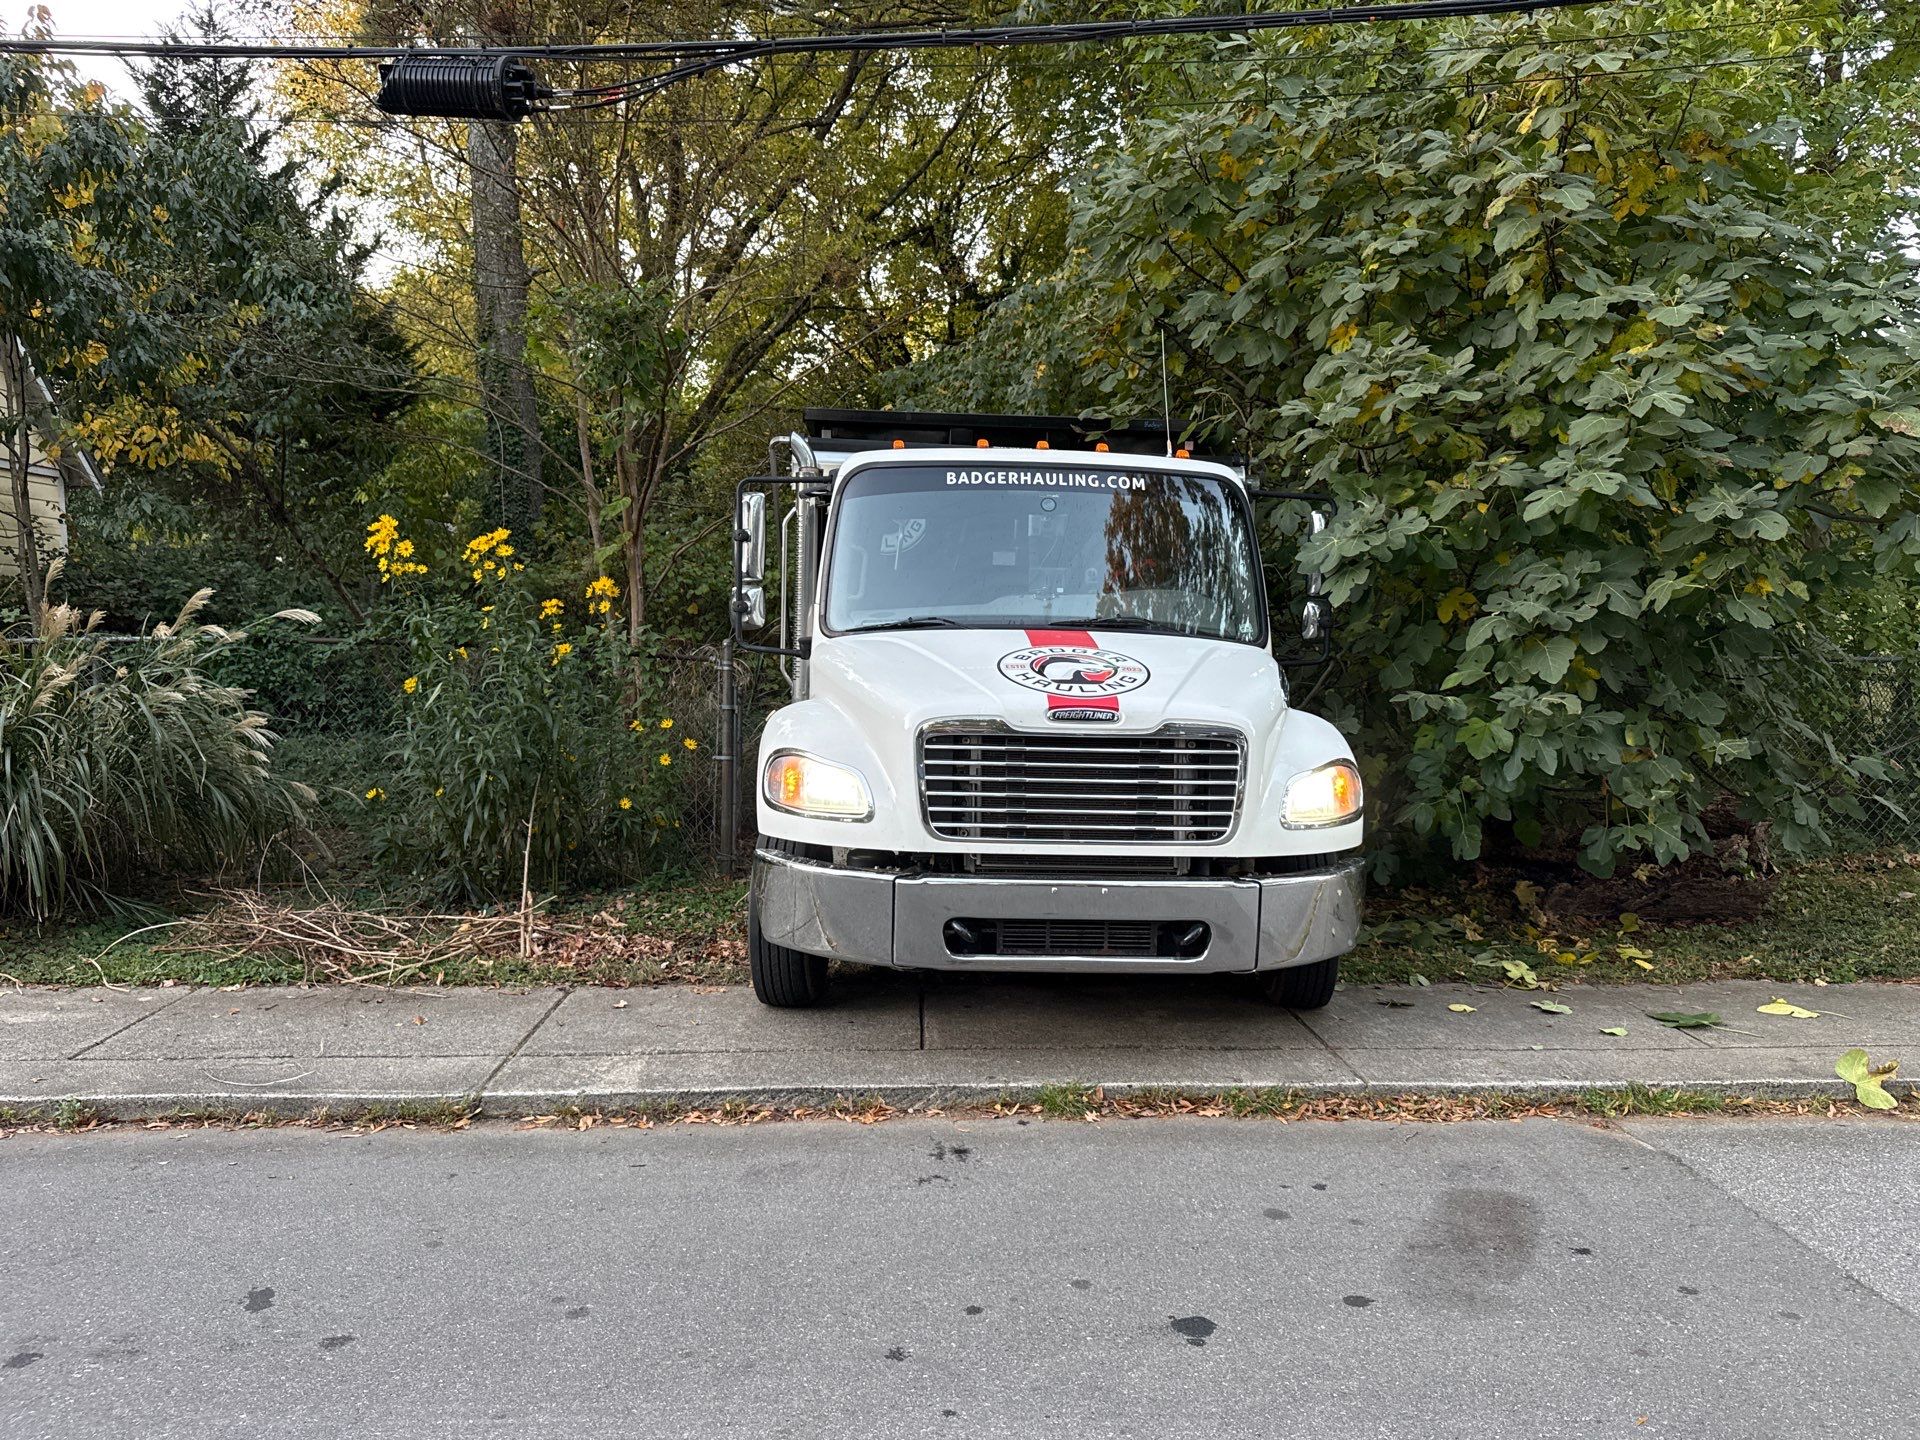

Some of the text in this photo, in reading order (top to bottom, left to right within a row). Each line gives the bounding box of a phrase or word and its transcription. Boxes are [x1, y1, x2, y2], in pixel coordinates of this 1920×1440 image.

[946, 471, 1146, 490] BADGERHAULING.COM
[1013, 648, 1128, 663] BADGER
[1015, 672, 1138, 693] HAULING
[1054, 711, 1113, 719] FREIGHTLINER
